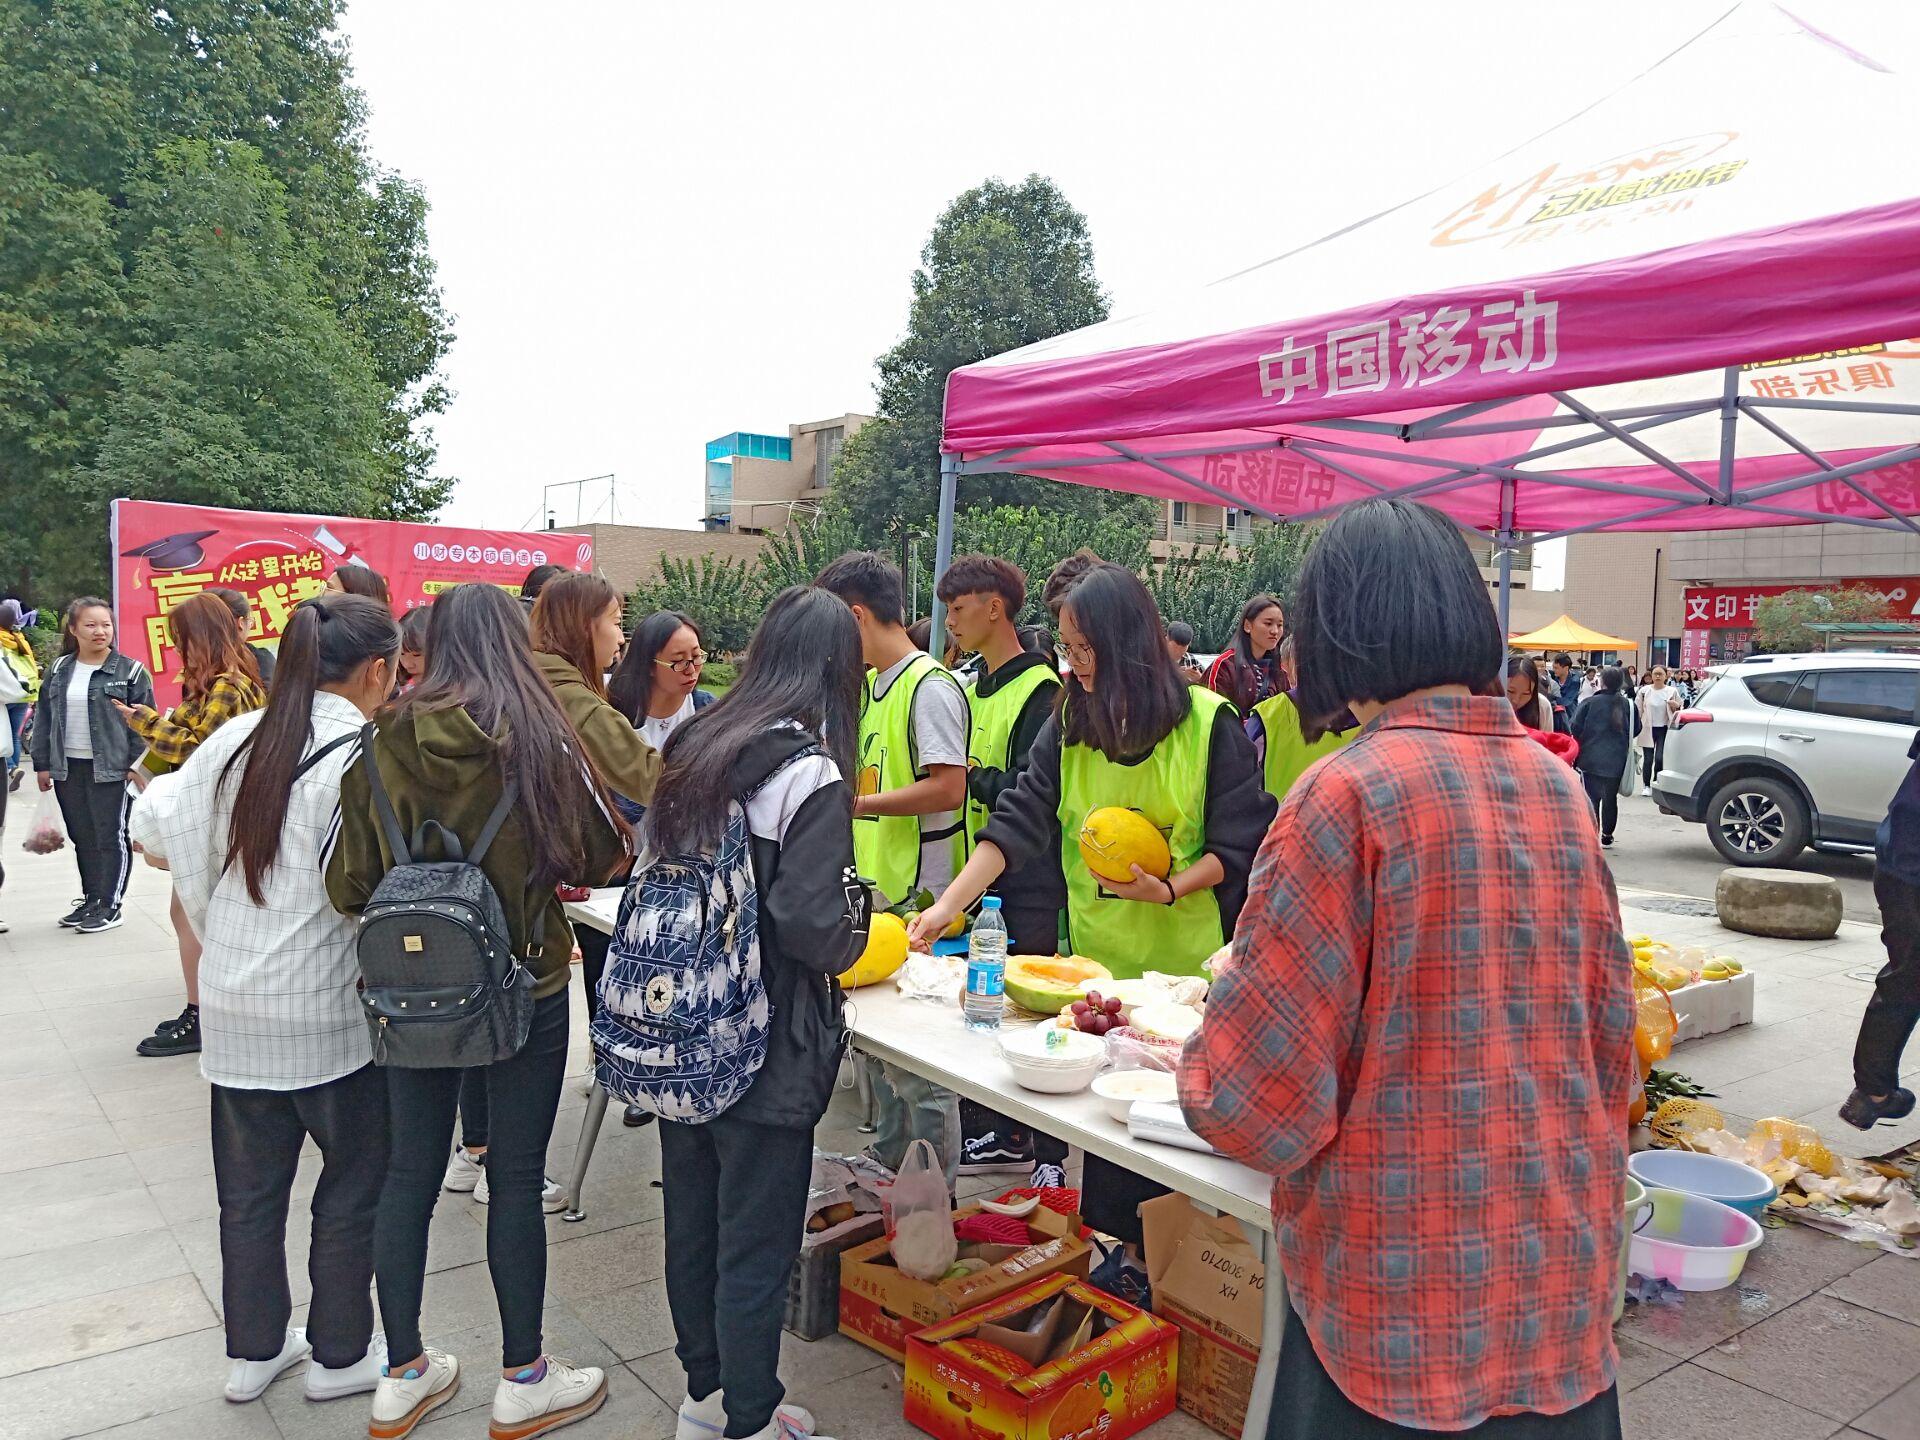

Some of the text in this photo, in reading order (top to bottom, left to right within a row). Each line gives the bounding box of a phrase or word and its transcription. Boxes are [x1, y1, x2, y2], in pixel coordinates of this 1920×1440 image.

[1259, 290, 1559, 406] 中国移动
[219, 550, 323, 583] 从这里开始
[414, 542, 547, 566] 川财专本硕直通车
[1218, 1283, 1239, 1301] HX
[936, 1363, 981, 1395] 北海一号
